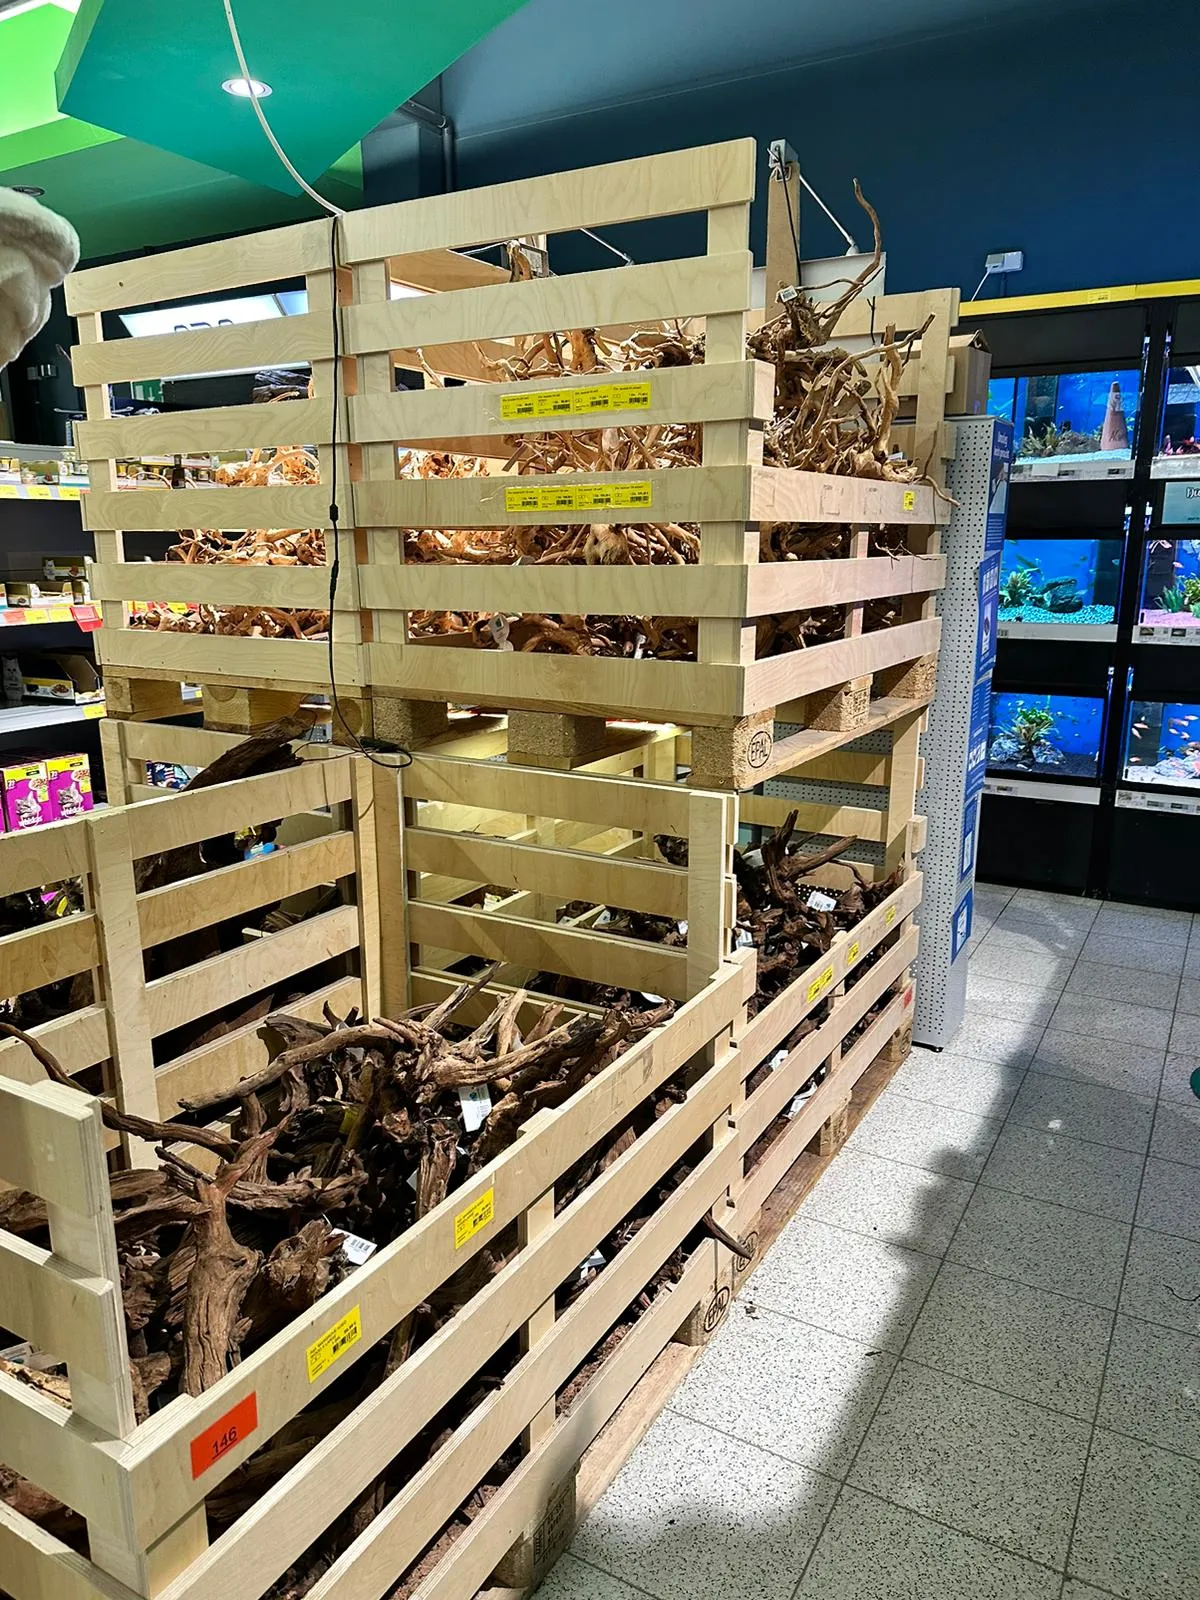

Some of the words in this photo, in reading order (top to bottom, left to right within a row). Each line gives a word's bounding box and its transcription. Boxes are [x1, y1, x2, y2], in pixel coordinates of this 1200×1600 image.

[751, 738, 768, 762] EPAL
[707, 1293, 727, 1329] EPAL
[212, 1426, 237, 1454] 146
